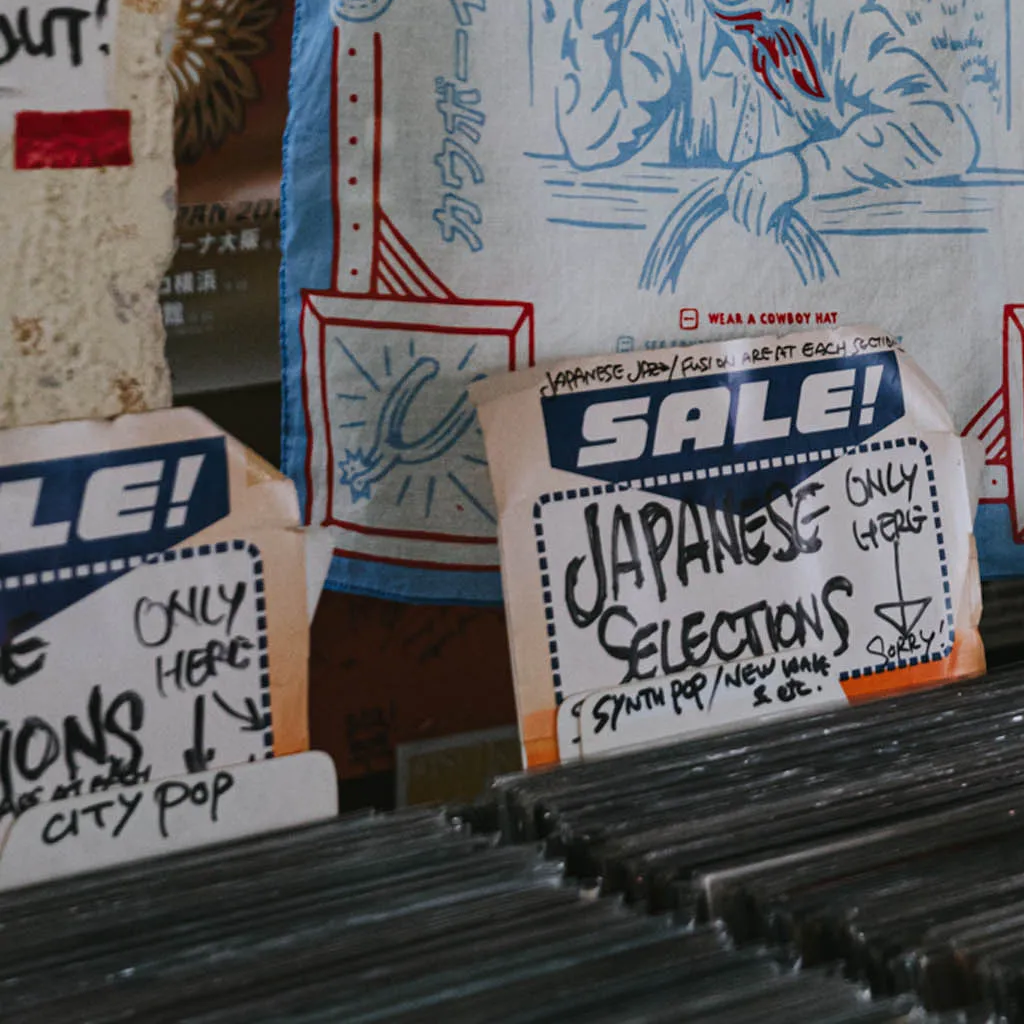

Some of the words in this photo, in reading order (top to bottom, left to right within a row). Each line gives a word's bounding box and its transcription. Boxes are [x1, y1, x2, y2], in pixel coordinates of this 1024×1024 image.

[707, 311, 744, 326] WEAR
[747, 311, 757, 325] A
[759, 311, 811, 326] COWBOY
[815, 311, 838, 325] HAT
[540, 364, 625, 398] JAPANESE
[741, 346, 773, 365] ARE
[801, 339, 847, 358] EACH
[577, 364, 885, 468] SALE!
[845, 461, 919, 508] ONLY
[564, 480, 830, 629] JAPANESE
[133, 580, 247, 648] ONLY
[597, 575, 854, 685] SELECTIONS
[866, 619, 946, 667] SORRY!
[155, 635, 256, 698] HERE
[592, 688, 665, 734] SYNTH
[41, 789, 144, 845] CITY
[153, 771, 234, 838] POP
